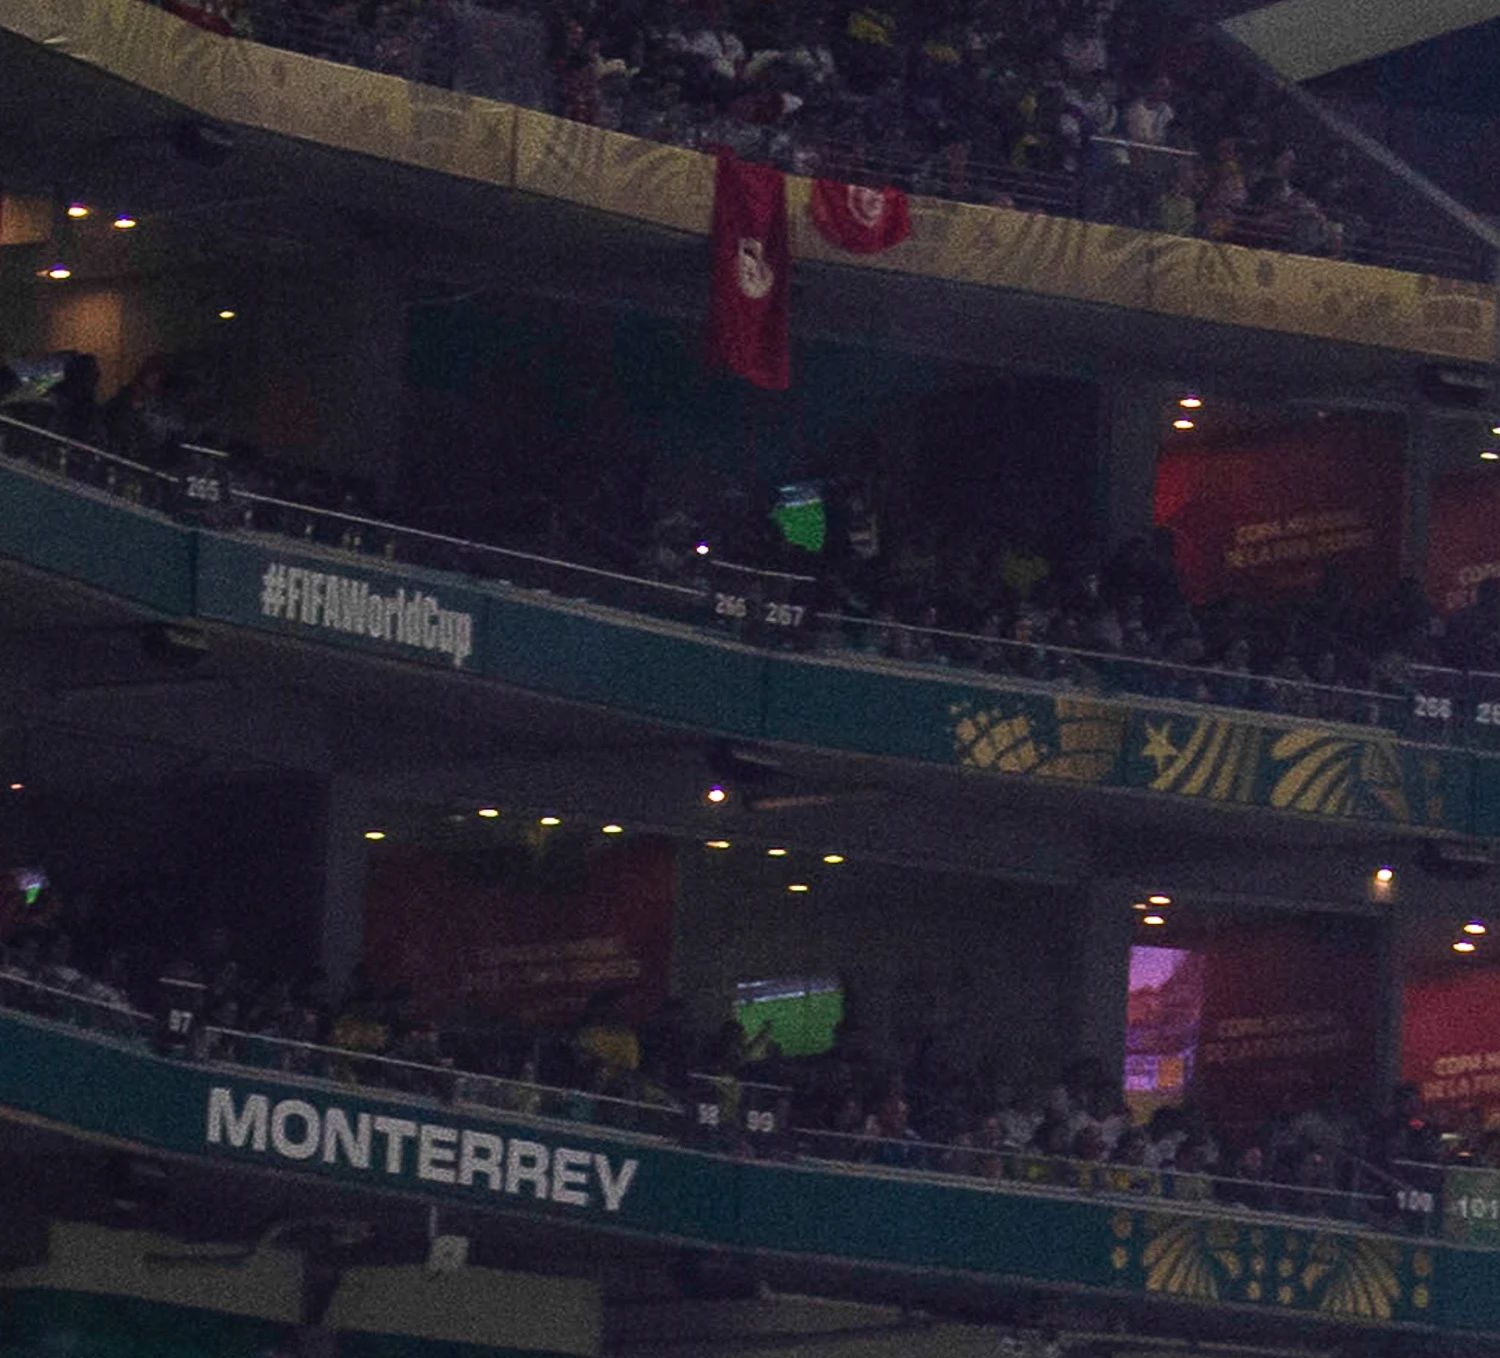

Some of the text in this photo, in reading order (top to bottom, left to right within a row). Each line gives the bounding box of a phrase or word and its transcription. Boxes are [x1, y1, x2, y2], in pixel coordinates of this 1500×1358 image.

[261, 562, 475, 668] #FIFAWorldCup
[206, 1086, 639, 1211] MONTERREY
[1457, 1196, 1500, 1220] 101
